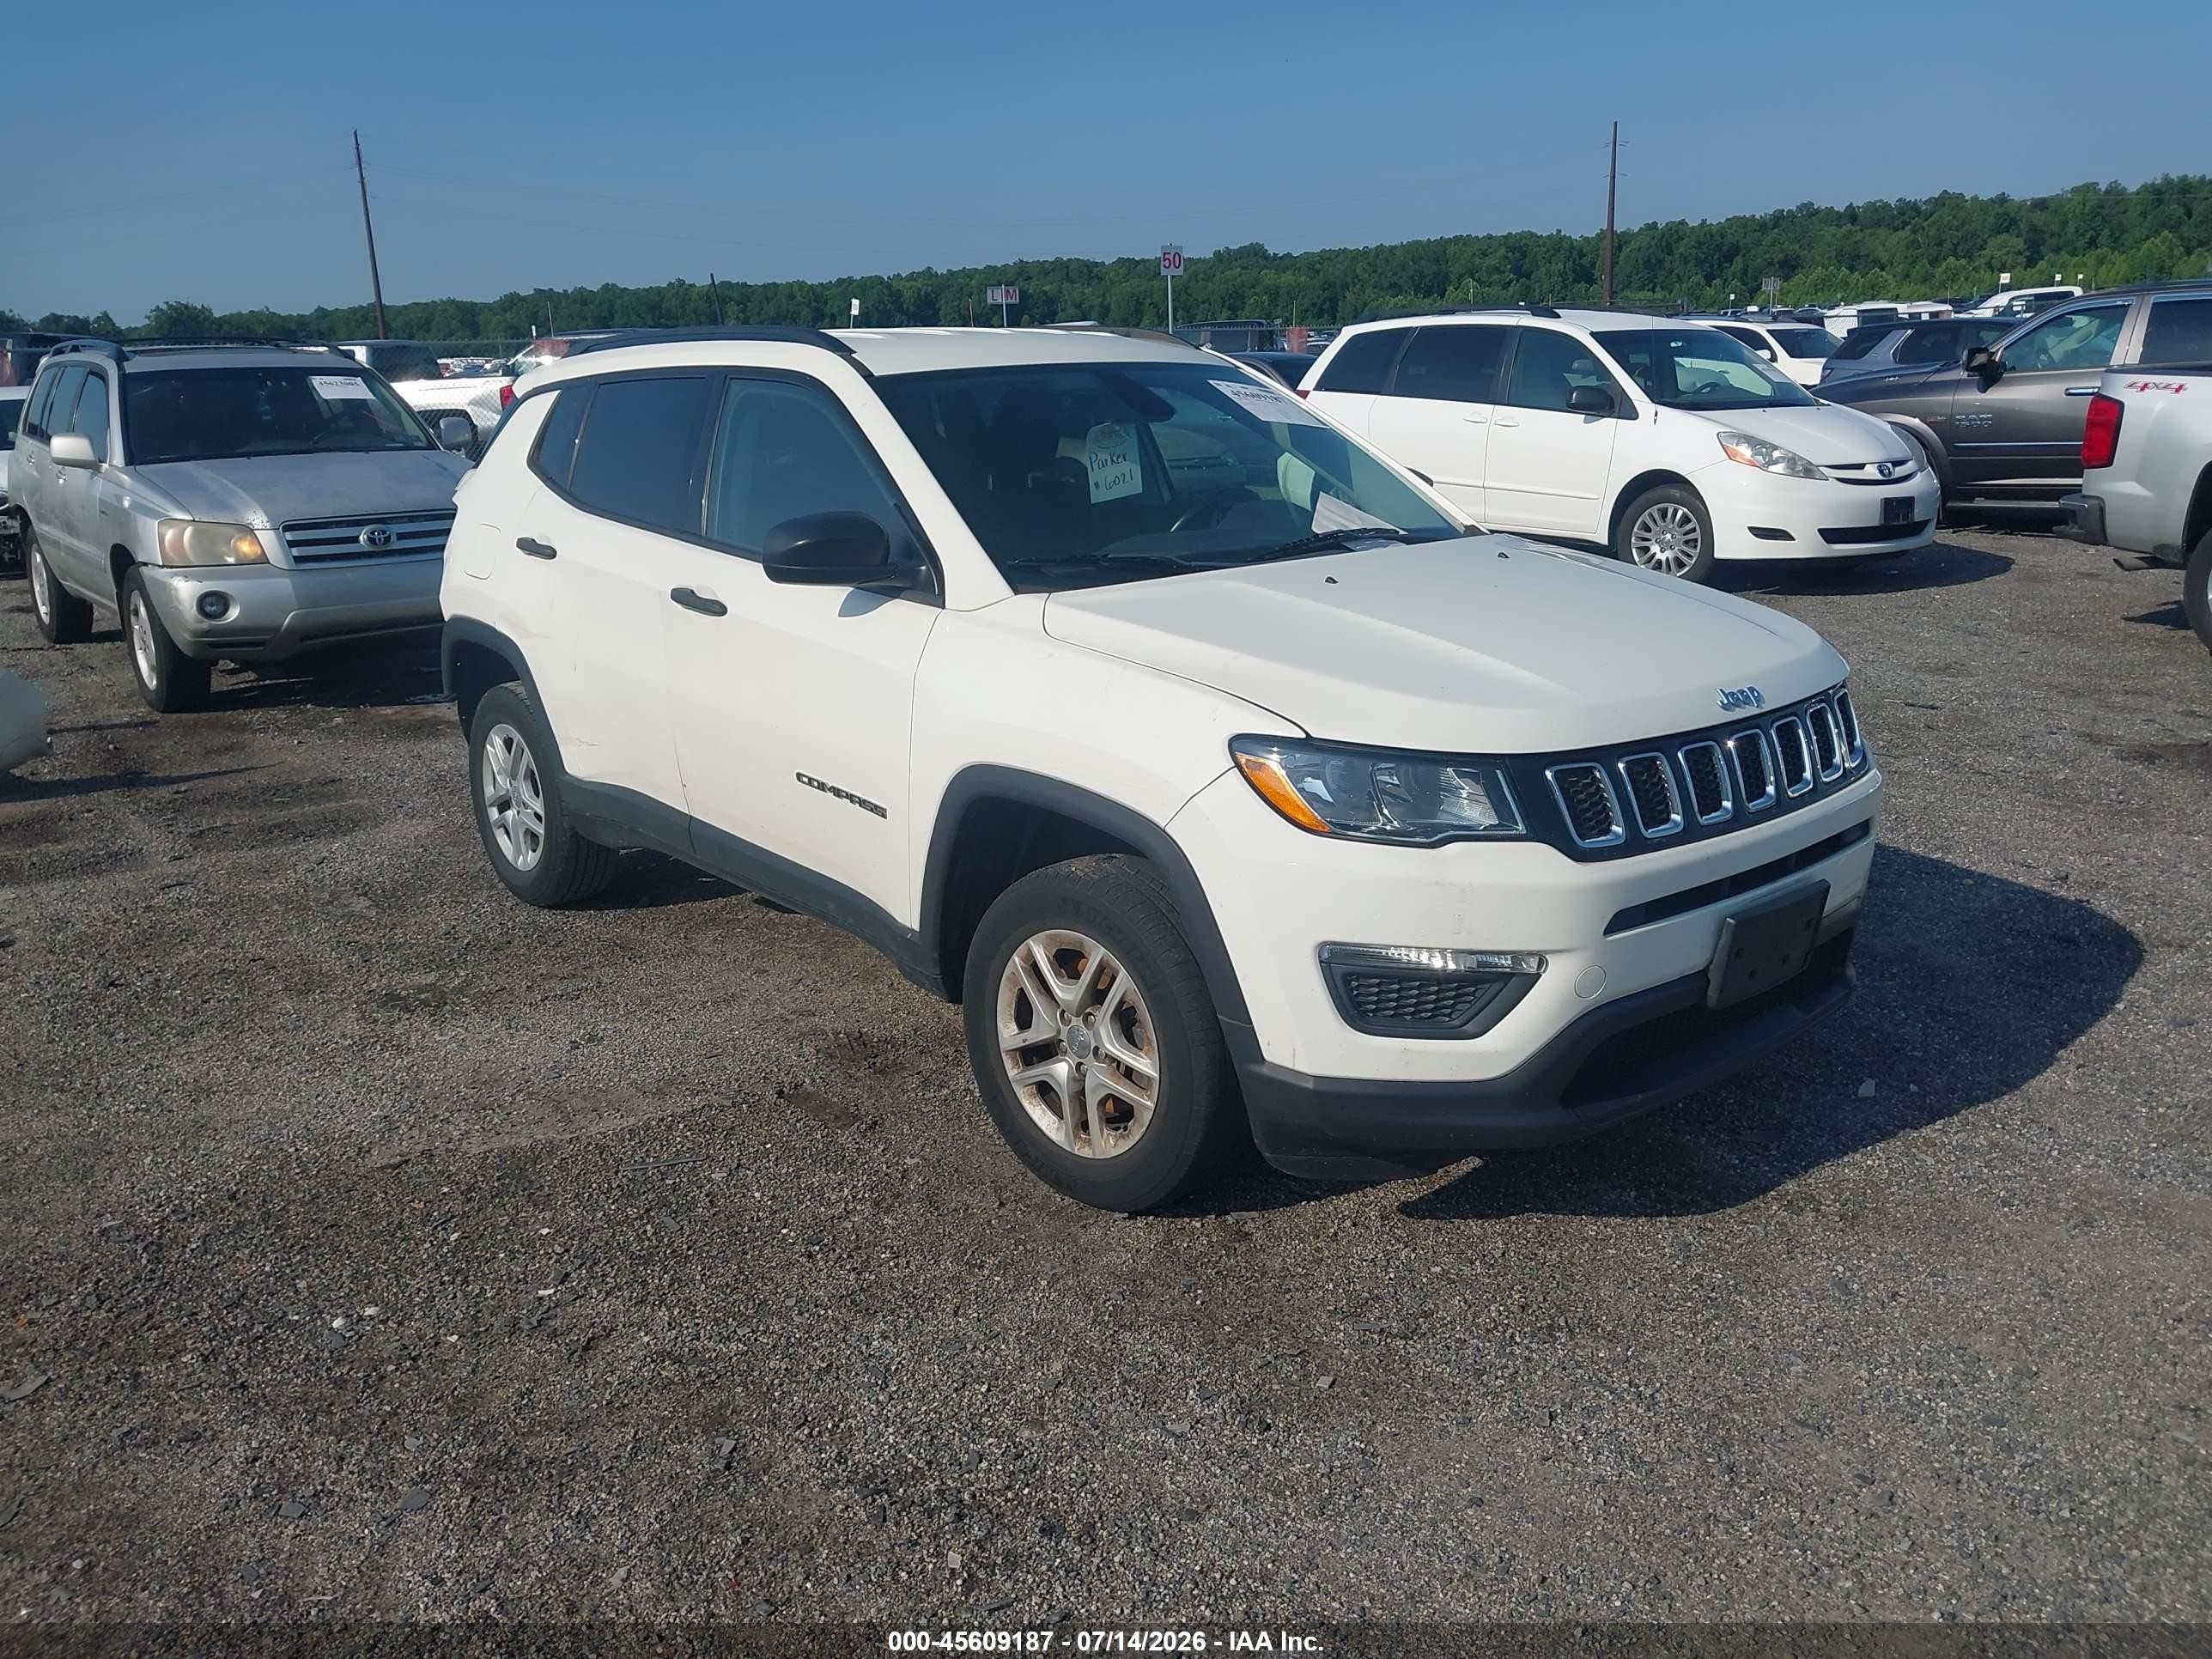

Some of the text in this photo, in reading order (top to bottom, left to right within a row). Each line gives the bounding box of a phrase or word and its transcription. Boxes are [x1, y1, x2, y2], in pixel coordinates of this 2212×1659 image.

[1163, 252, 1182, 270] 50
[991, 289, 998, 301] L
[1006, 289, 1018, 301] M
[1104, 468, 1133, 491] 6021
[1717, 686, 1765, 713] Jeep
[795, 771, 888, 820] COMPASS
